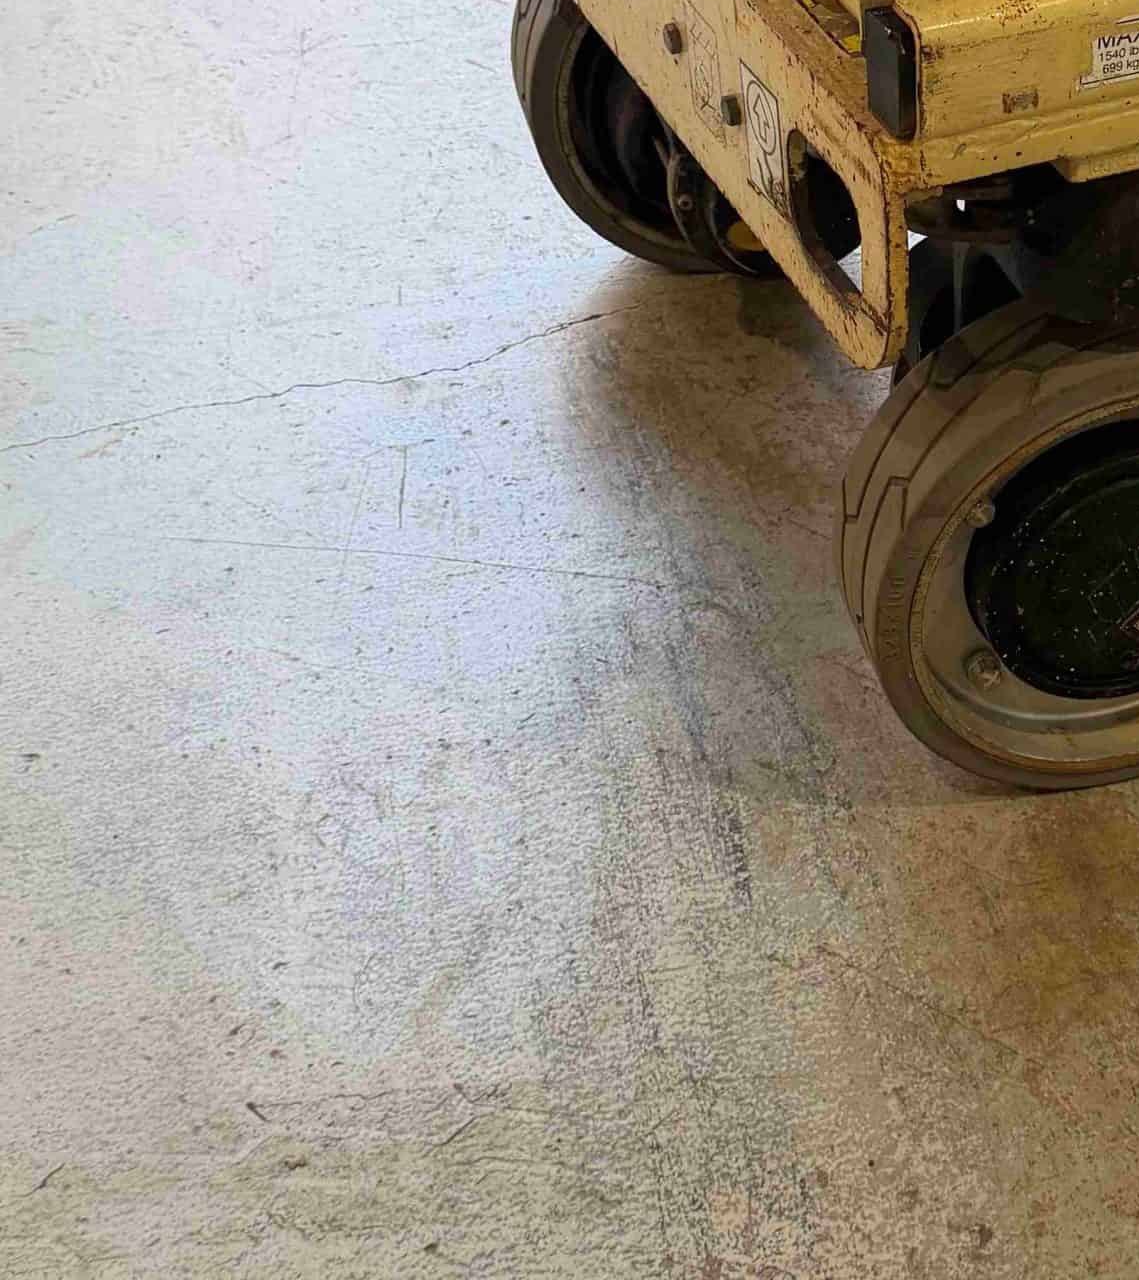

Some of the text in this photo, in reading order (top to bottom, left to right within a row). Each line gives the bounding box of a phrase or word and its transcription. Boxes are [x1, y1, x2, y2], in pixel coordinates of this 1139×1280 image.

[1100, 47, 1126, 62] 1540
[1103, 59, 1139, 74] 699 kg
